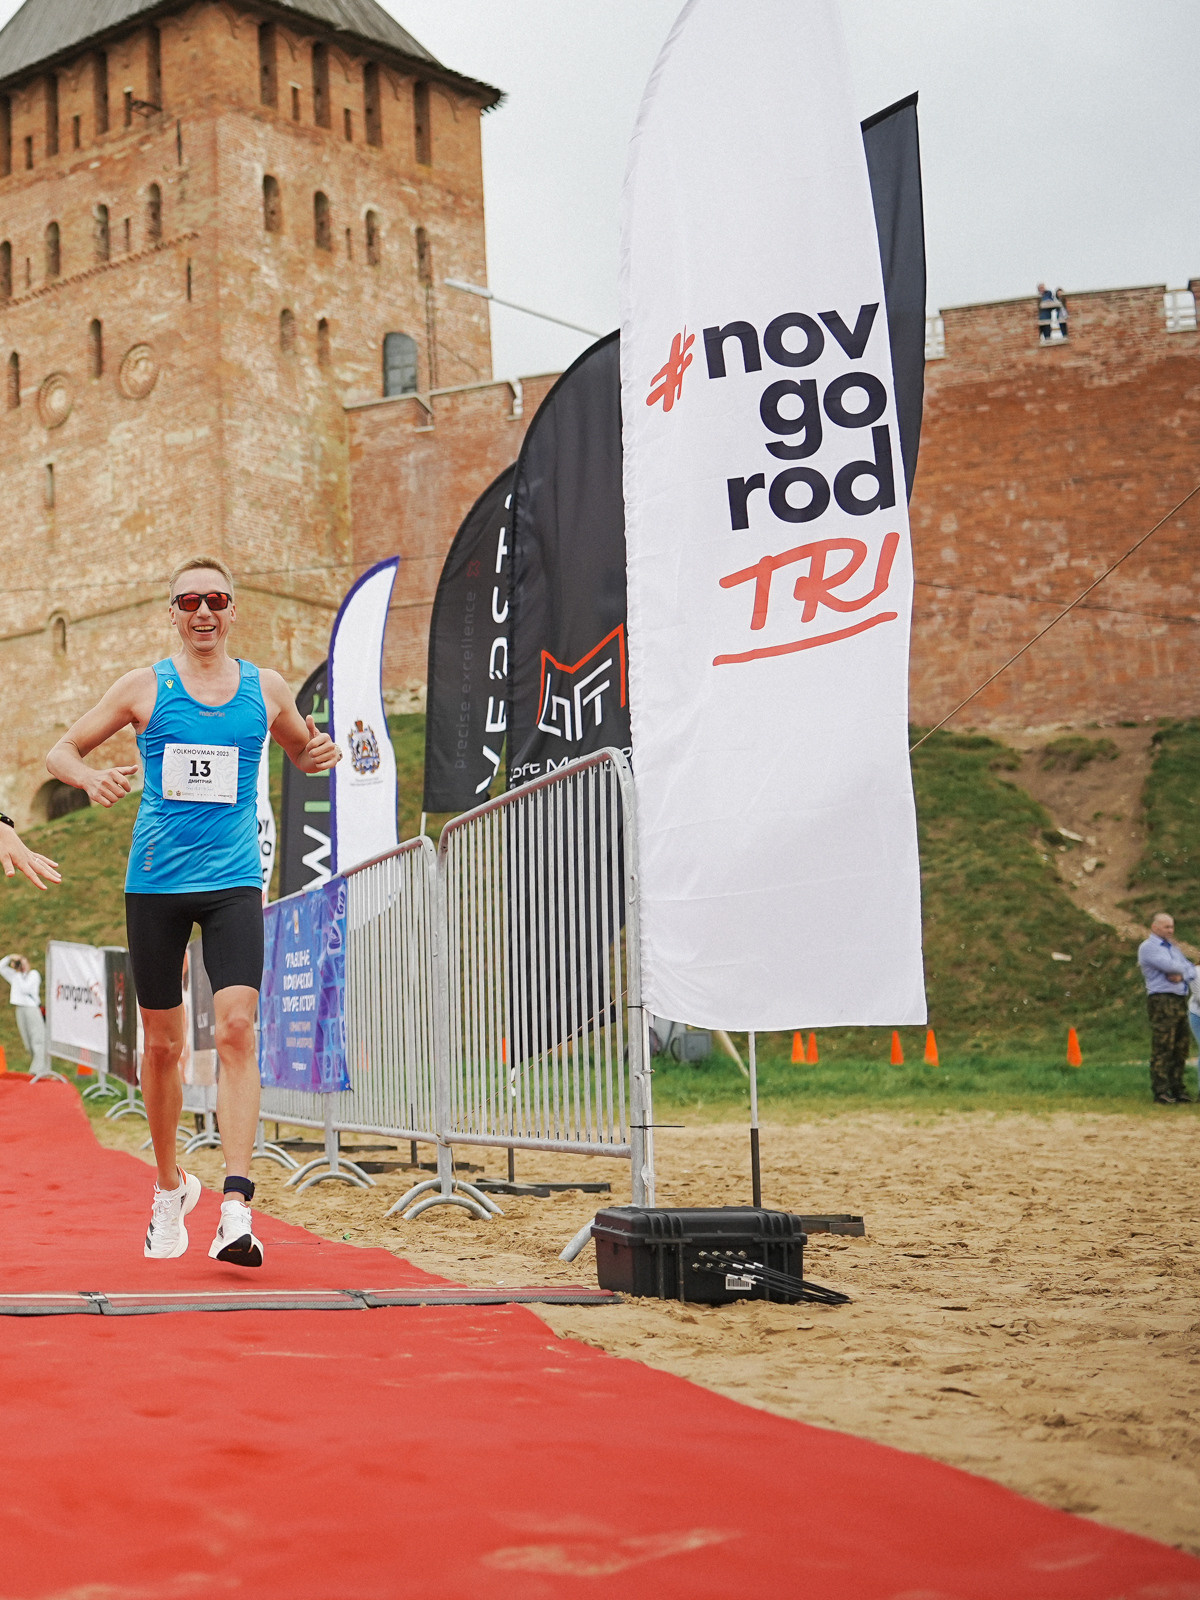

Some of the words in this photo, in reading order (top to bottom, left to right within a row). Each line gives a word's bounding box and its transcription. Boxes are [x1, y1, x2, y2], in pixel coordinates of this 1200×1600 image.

[646, 302, 880, 412] #nov
[759, 371, 888, 461] go
[726, 424, 896, 531] rod
[718, 532, 900, 631] TRI
[462, 591, 477, 695] excellence
[173, 748, 215, 756] VOLKHOVMAN
[189, 760, 211, 777] 13
